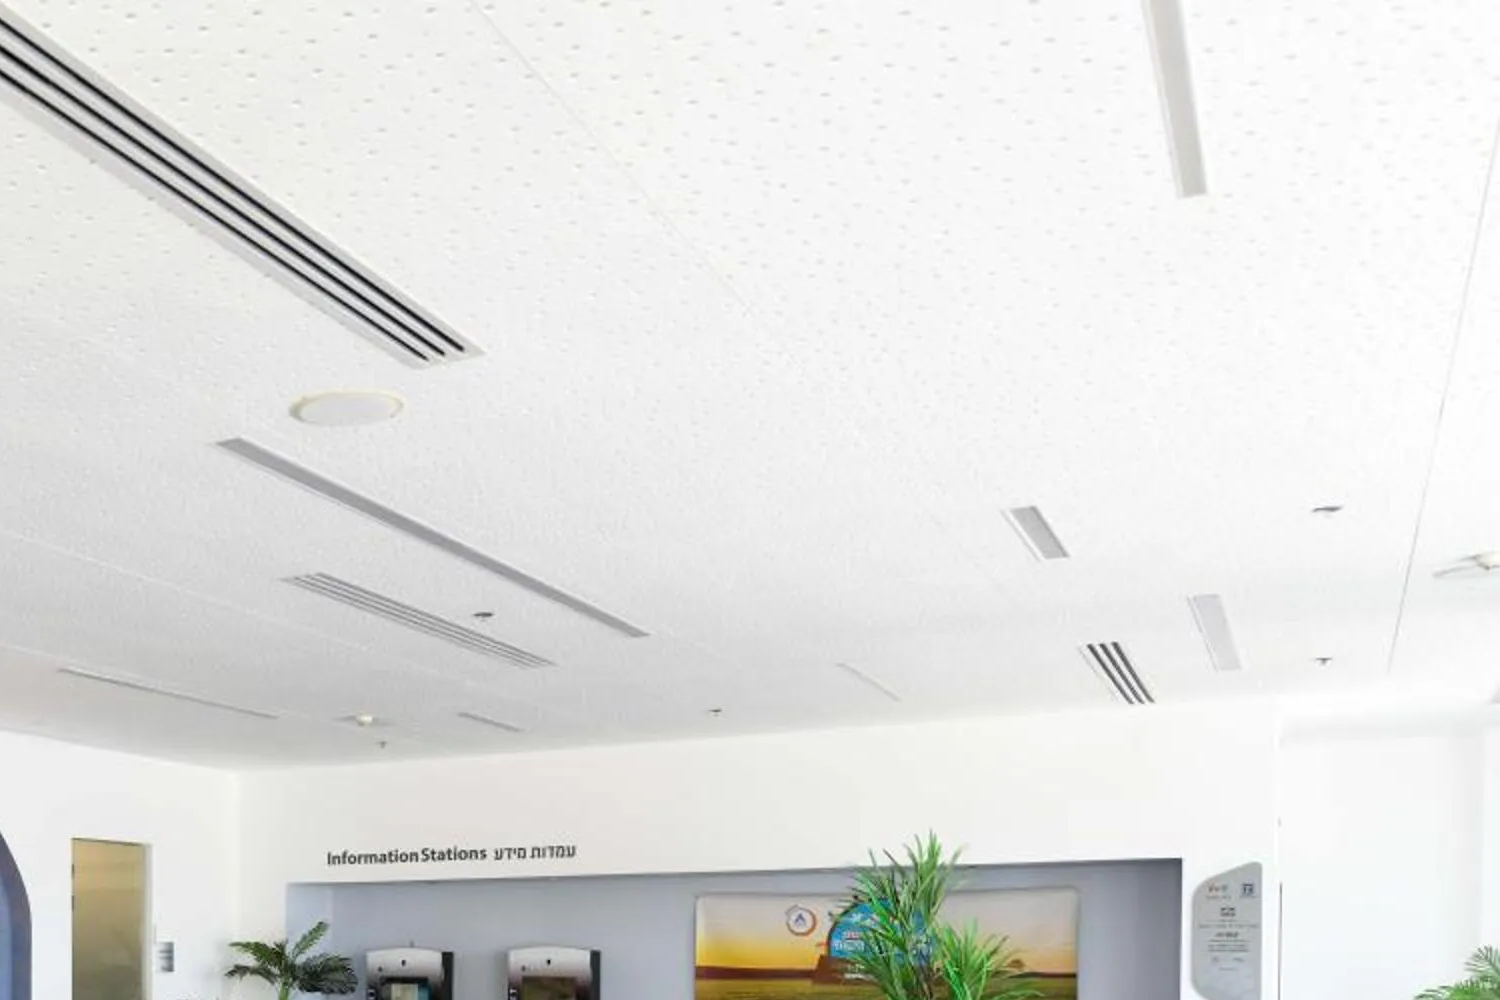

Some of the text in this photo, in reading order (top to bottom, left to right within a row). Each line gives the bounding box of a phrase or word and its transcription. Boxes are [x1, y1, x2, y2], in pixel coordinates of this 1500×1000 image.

[327, 846, 487, 865] Information Stations
[494, 845, 576, 860] עמדות מידע
